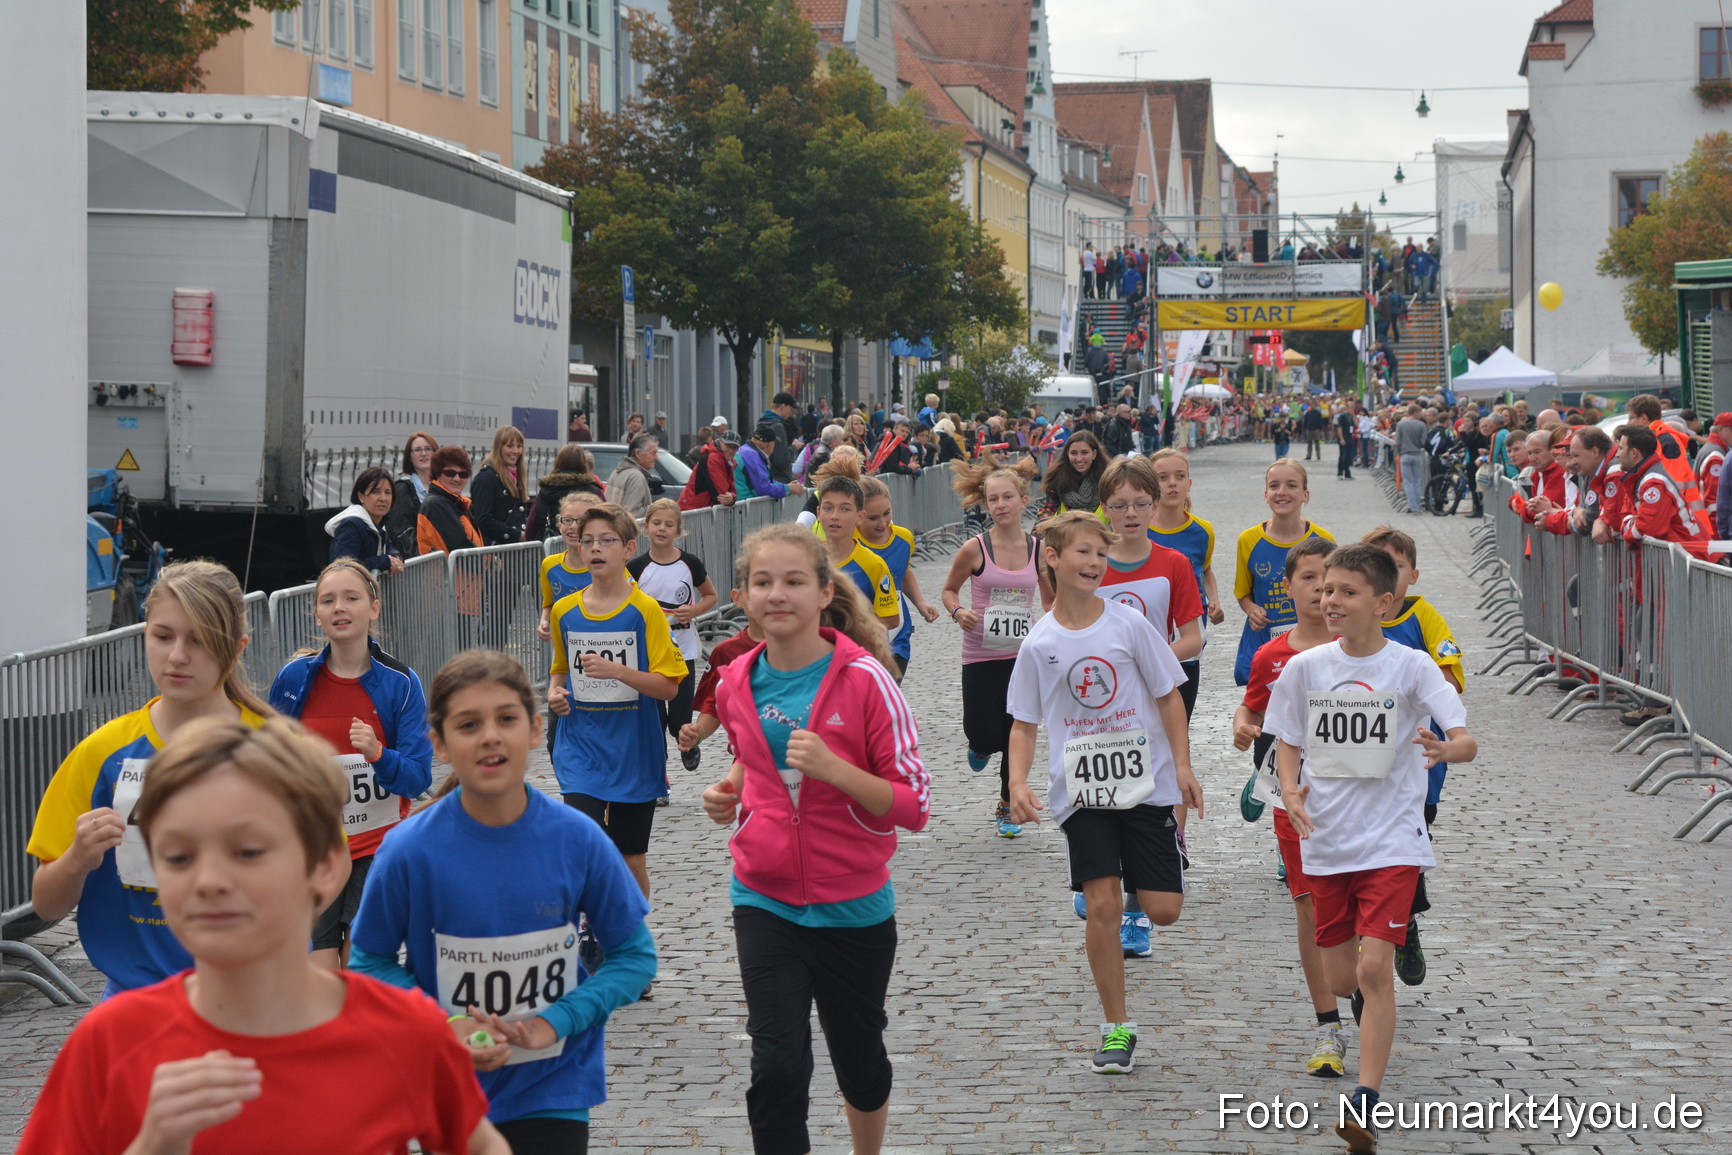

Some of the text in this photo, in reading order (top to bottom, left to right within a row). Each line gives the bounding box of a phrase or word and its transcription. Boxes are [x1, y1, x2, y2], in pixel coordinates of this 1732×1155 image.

[514, 259, 561, 331] BOCK
[1225, 305, 1297, 323] START
[1246, 382, 1253, 390] A
[989, 617, 1030, 637] 4105
[568, 638, 623, 647] PARTL Neumarkt
[578, 679, 619, 692] JUSTUS
[1309, 699, 1380, 708] PARTL Neumarkt
[1096, 715, 1113, 725] MIT
[1115, 708, 1137, 721] HERZ
[1315, 712, 1389, 744] 4004
[1065, 738, 1135, 753] PARTL Neumarkt
[1074, 749, 1144, 783] 4003
[1072, 785, 1118, 808] ALEX
[341, 812, 368, 825] Lara
[440, 942, 560, 963] PARTL Neumarkt
[451, 957, 566, 1017] 4048
